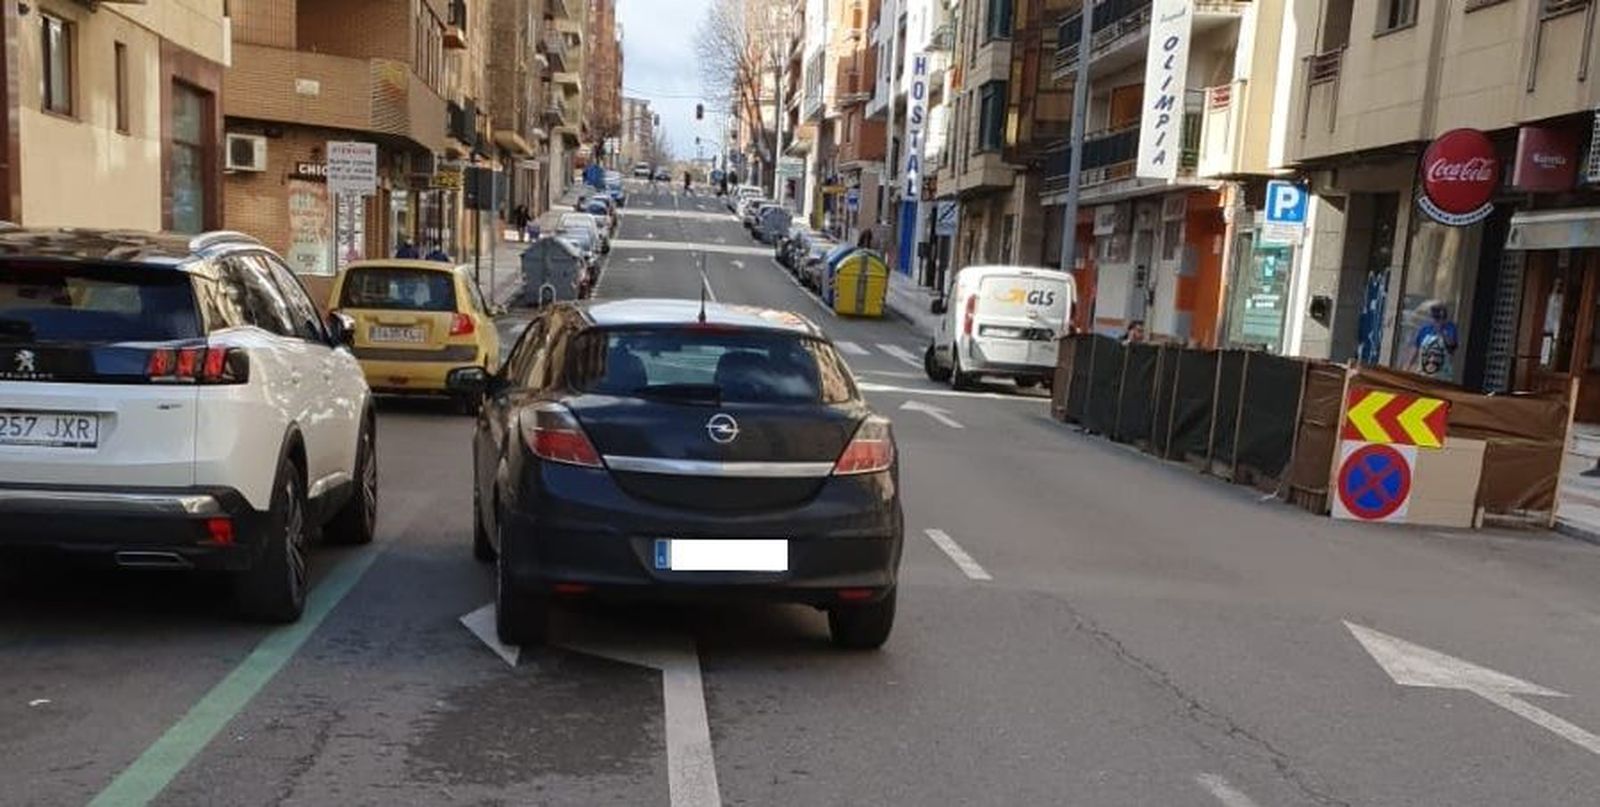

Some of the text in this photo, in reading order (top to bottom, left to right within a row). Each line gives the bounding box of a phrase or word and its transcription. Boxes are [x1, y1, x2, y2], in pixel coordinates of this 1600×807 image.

[1152, 36, 1179, 166] OLIMPIA
[906, 56, 926, 196] HOSTAL
[1428, 157, 1495, 183] Coca-Cola
[1273, 186, 1300, 218] P
[1027, 290, 1055, 306] GLS
[47, 416, 90, 439] JXR
